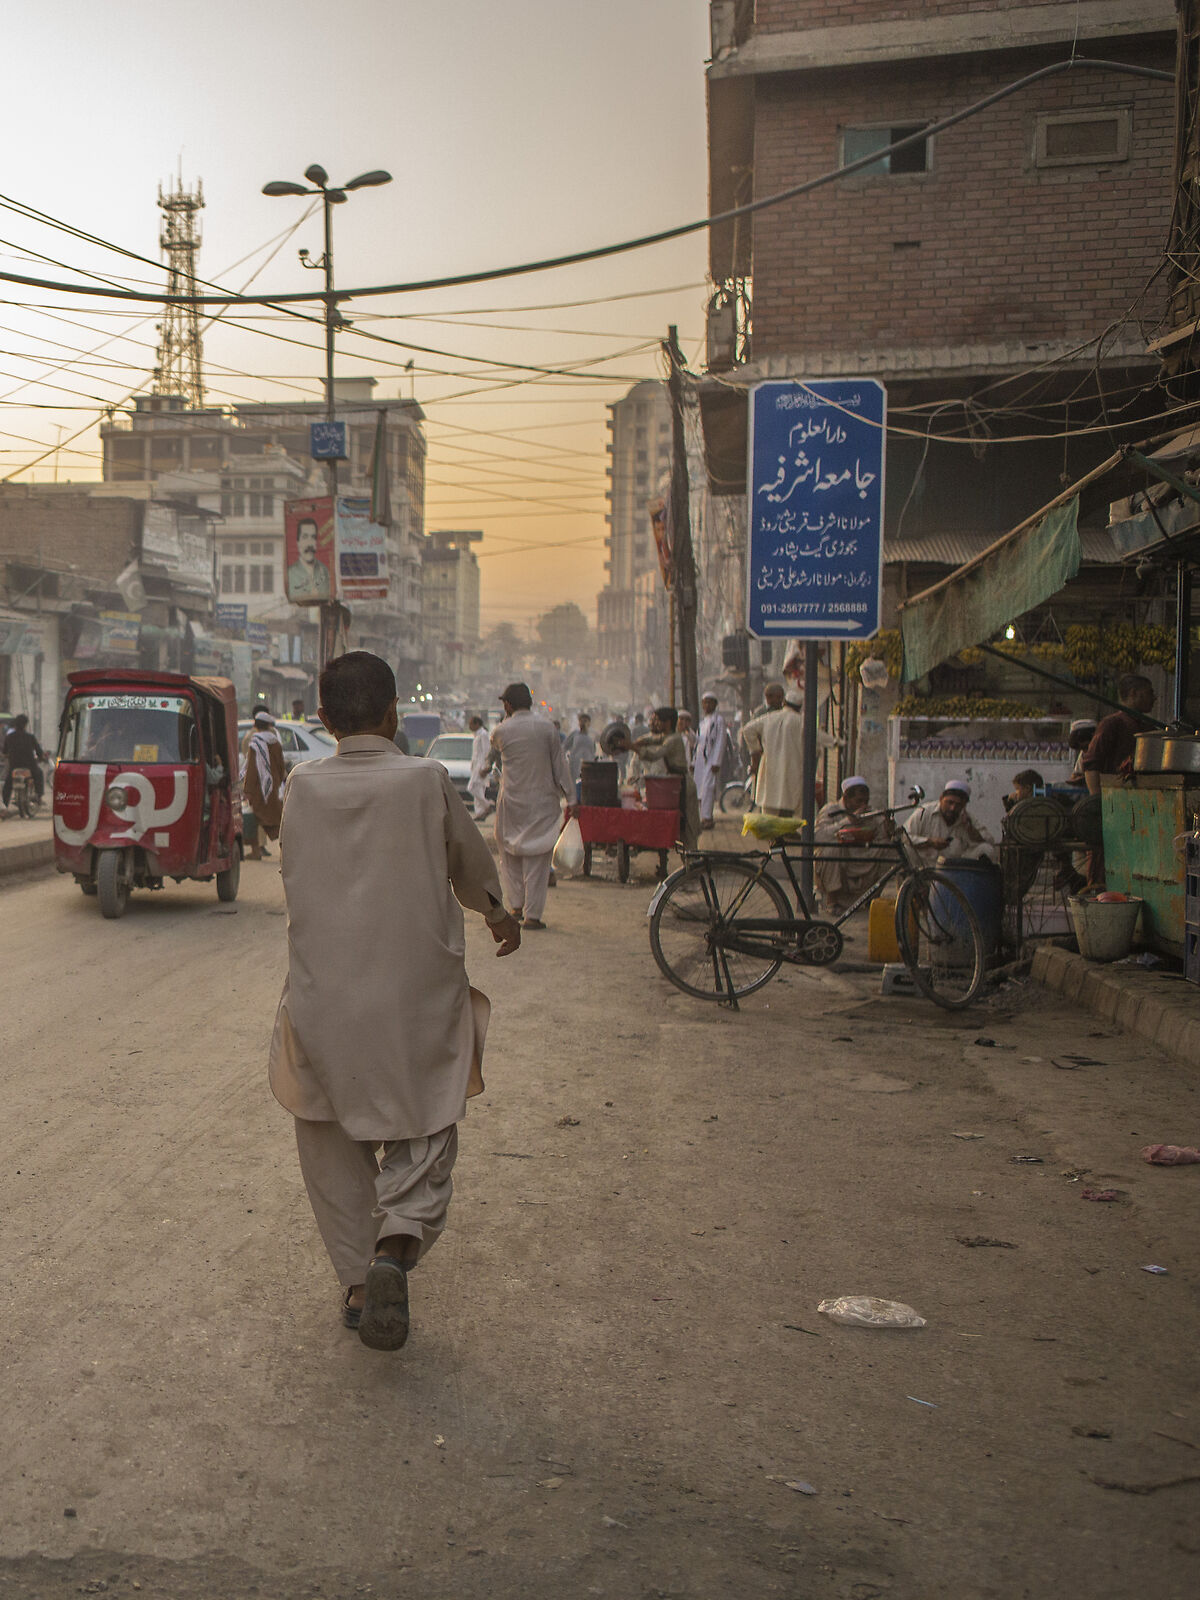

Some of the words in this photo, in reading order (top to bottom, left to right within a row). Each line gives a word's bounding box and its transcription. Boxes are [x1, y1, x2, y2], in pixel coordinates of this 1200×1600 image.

[757, 450, 821, 503] اشرفیہ
[812, 456, 877, 500] جامعہ
[806, 511, 841, 535] اشرف
[772, 540, 799, 562] پشاور
[799, 535, 831, 558] گیٹ
[757, 564, 785, 590] قریشی
[782, 564, 798, 590] علی
[793, 569, 816, 588] ارشد
[816, 570, 843, 586] مولانا
[760, 602, 820, 614] 091-2567777
[827, 602, 869, 614] 2568888
[54, 764, 189, 848] بول
